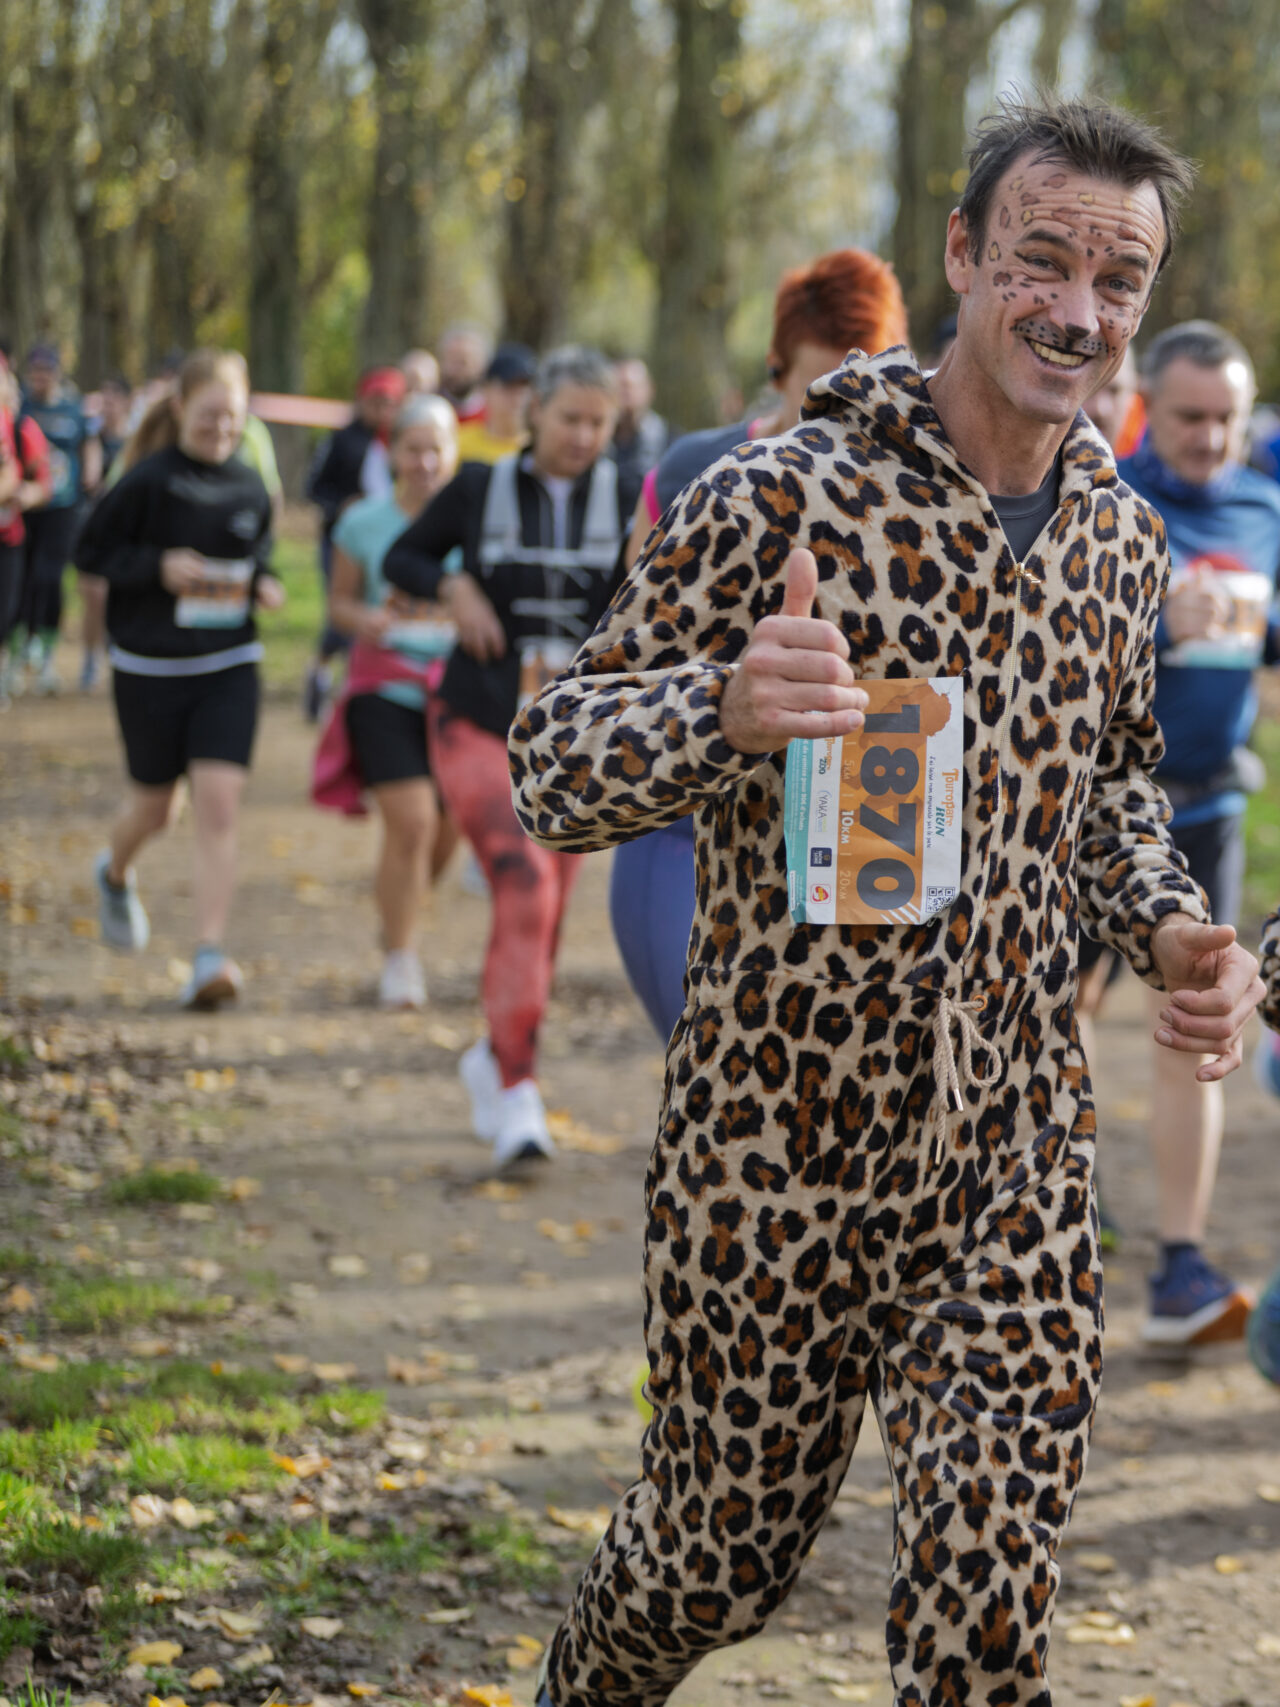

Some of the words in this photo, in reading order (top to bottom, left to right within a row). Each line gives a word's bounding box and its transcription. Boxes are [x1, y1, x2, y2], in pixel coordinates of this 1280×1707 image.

[856, 704, 920, 911] 1870
[941, 768, 960, 827] Touroparc
[840, 810, 855, 844] 10KM
[935, 807, 946, 837] RUN
[838, 870, 851, 901] 20KM
